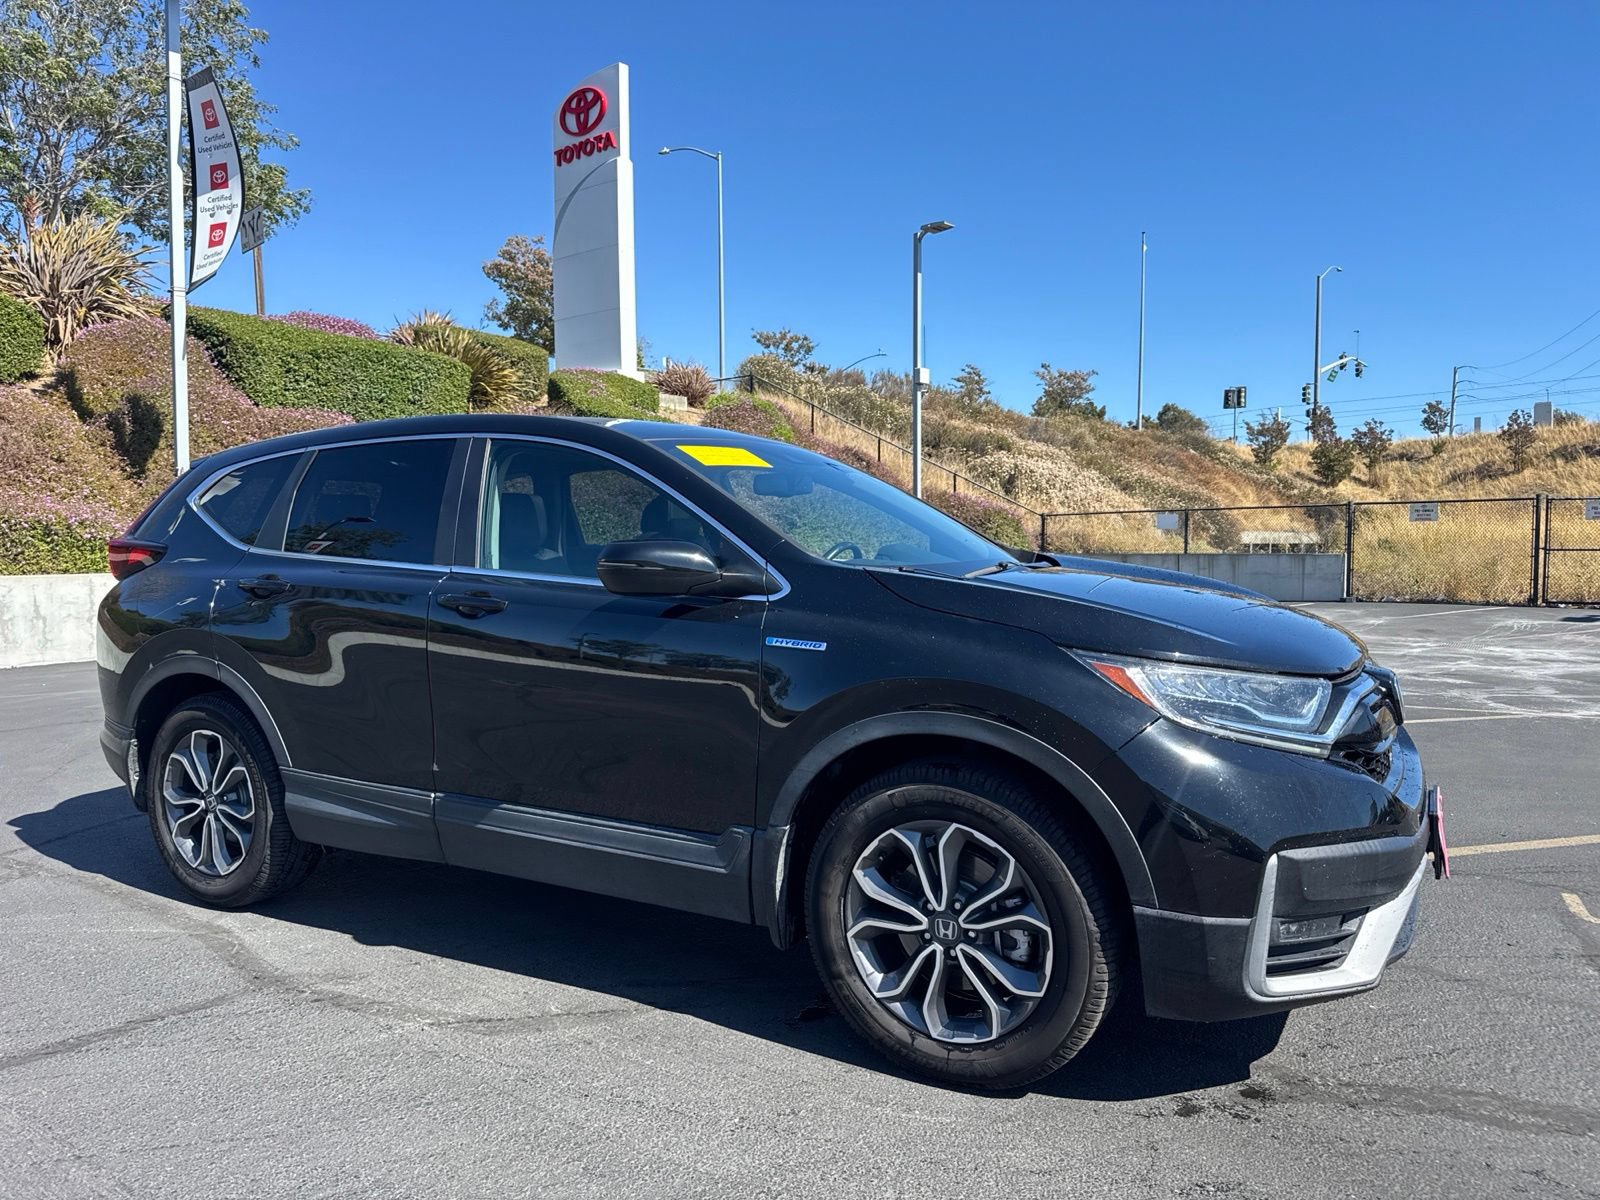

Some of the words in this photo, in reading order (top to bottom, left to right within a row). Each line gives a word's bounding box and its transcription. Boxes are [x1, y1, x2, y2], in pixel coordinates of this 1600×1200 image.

[204, 132, 225, 143] Certified
[197, 145, 213, 154] Used
[554, 132, 616, 166] TOYOTA
[208, 194, 232, 203] Certified
[200, 204, 216, 214] Used
[216, 202, 239, 211] Vehicles
[774, 639, 822, 649] HYBRID
